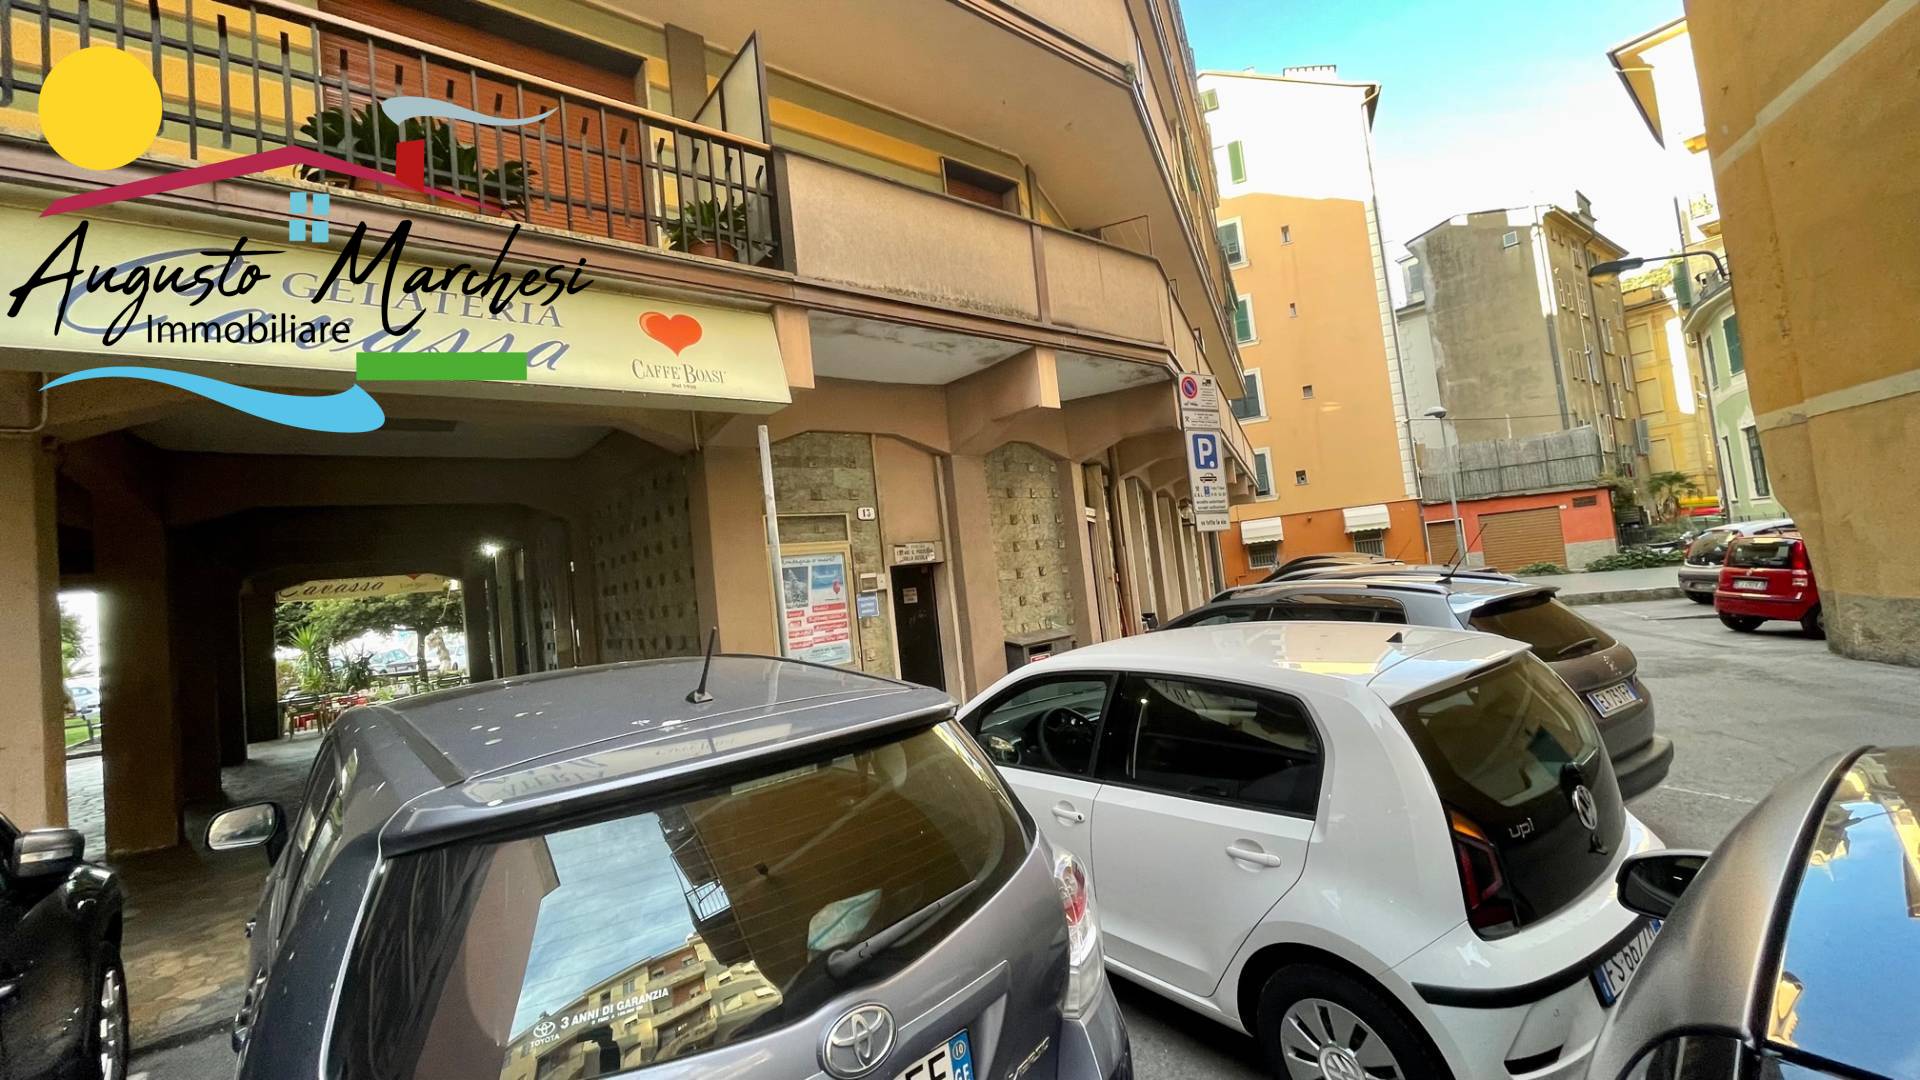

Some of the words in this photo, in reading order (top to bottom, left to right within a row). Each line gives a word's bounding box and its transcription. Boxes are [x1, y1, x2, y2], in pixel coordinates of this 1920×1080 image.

[282, 272, 565, 328] GELATERIA
[560, 1016, 570, 1029] 3
[571, 1007, 600, 1026] ANNI
[602, 1005, 614, 1016] DI
[616, 987, 670, 1011] GARANZIA
[530, 1033, 560, 1048] TOYOTA
